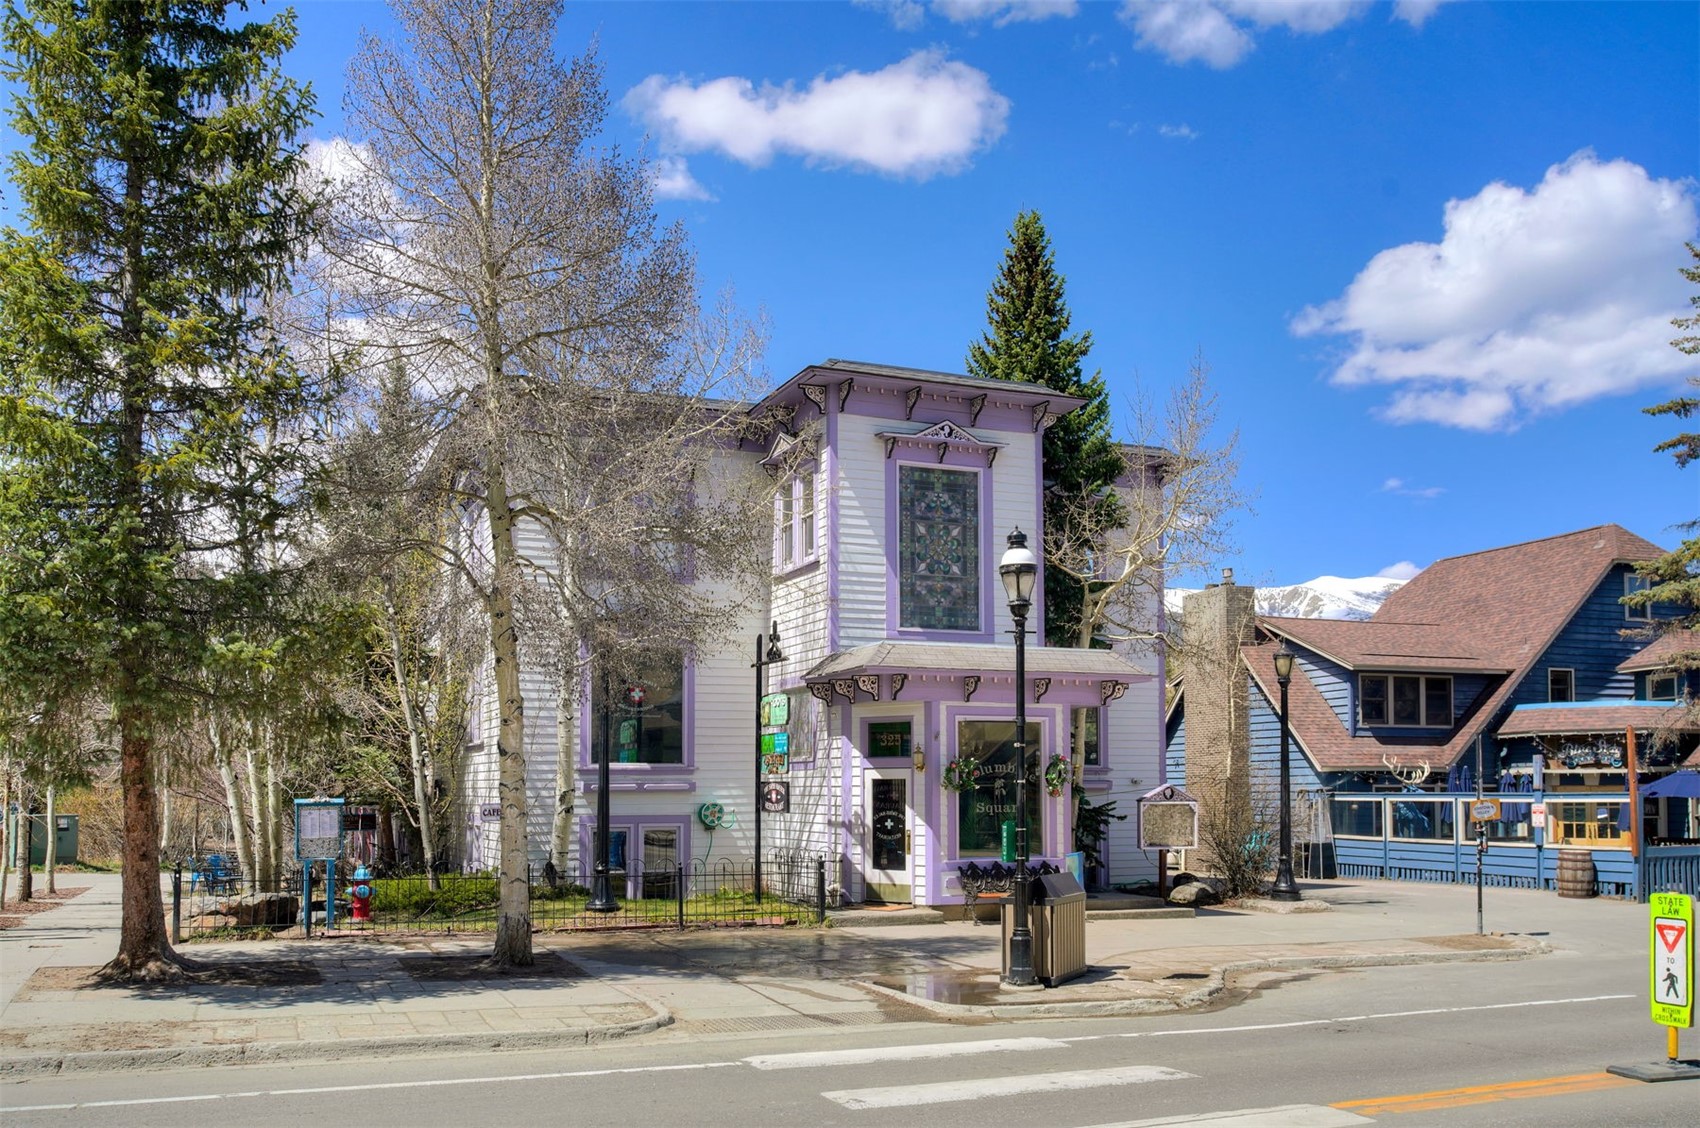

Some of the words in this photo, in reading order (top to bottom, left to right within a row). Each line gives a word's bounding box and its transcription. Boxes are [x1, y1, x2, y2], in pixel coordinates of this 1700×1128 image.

[879, 734, 902, 746] 325
[976, 802, 1017, 815] Squar
[1657, 896, 1684, 907] STATE
[1661, 907, 1680, 916] LAW
[1661, 1007, 1681, 1015] WITHIN
[1655, 1014, 1686, 1024] CROSSWALK
